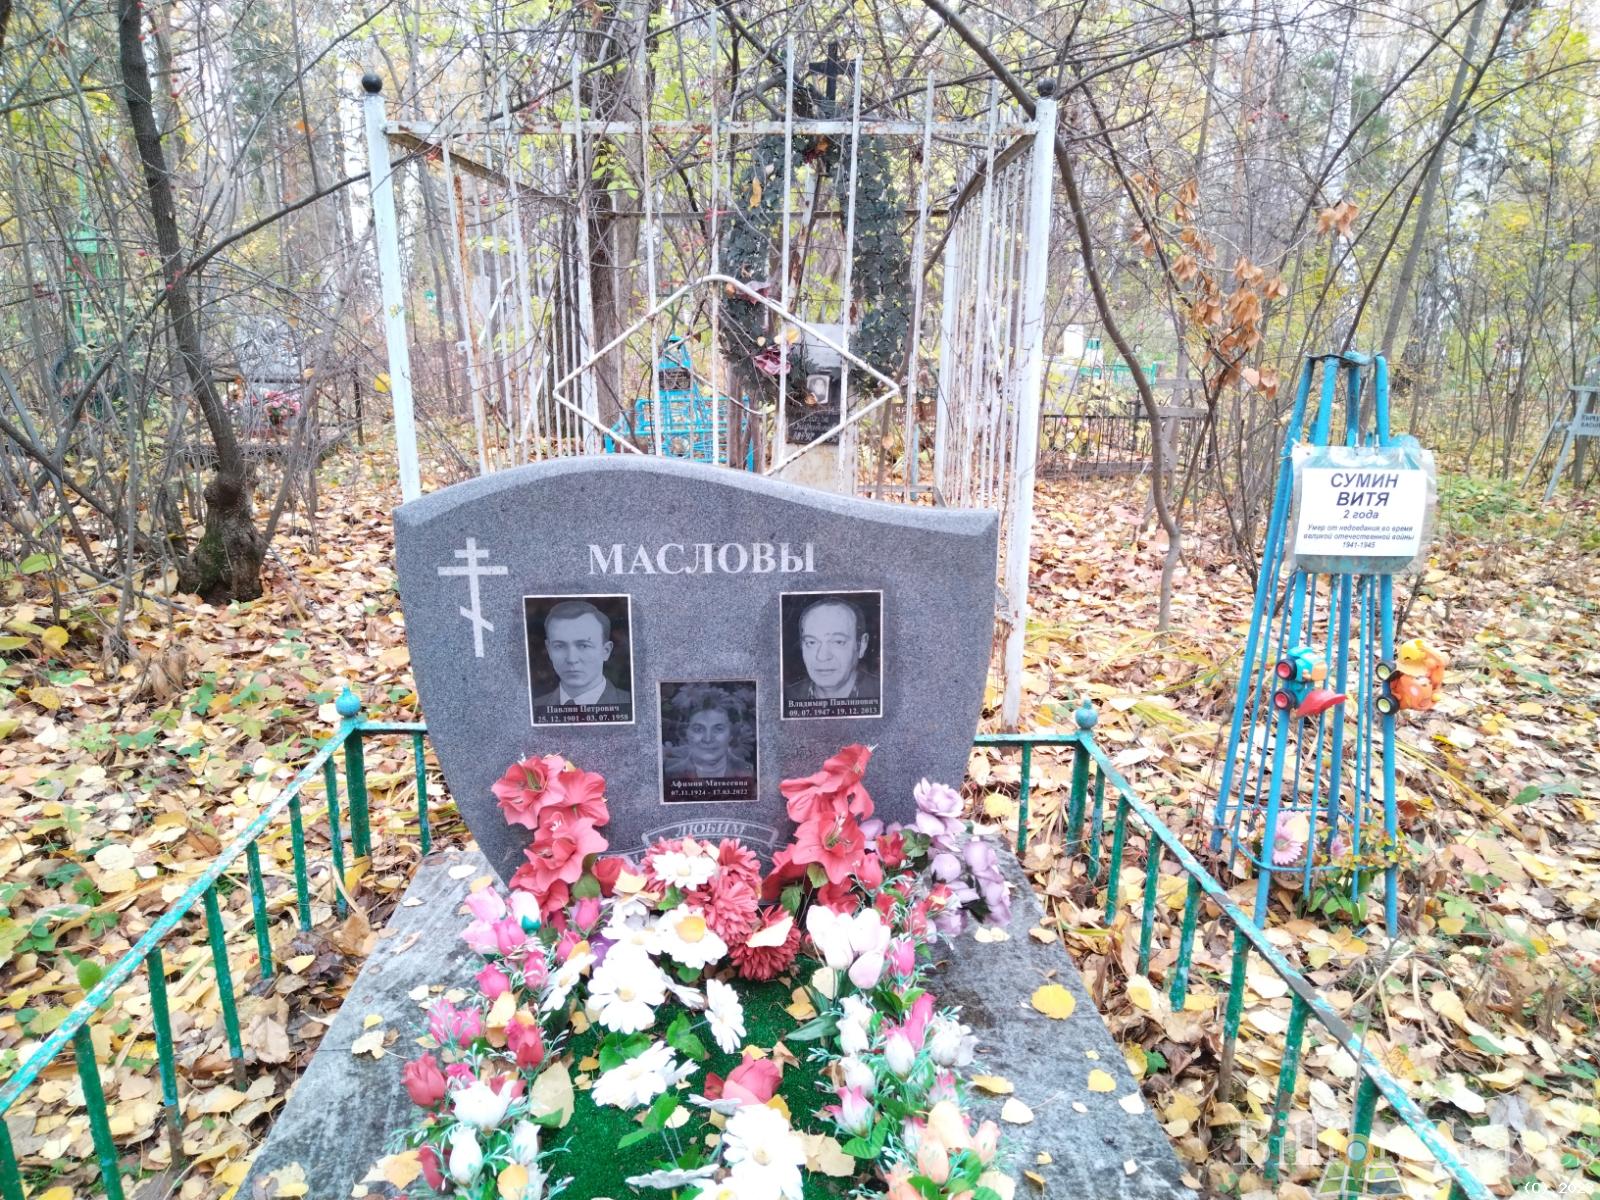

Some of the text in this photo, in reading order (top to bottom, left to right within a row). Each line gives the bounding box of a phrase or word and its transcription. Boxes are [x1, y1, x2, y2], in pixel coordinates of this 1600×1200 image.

[1330, 472, 1399, 488] СУМИН
[1336, 491, 1390, 506] ВИТЯ
[1343, 510, 1380, 519] 2 года
[1307, 524, 1325, 532] Умер
[1338, 524, 1380, 532] недоедания
[587, 542, 817, 575] МАСЛОВЫ
[788, 700, 829, 708] Владимир
[546, 705, 620, 714] Павлин Петрович
